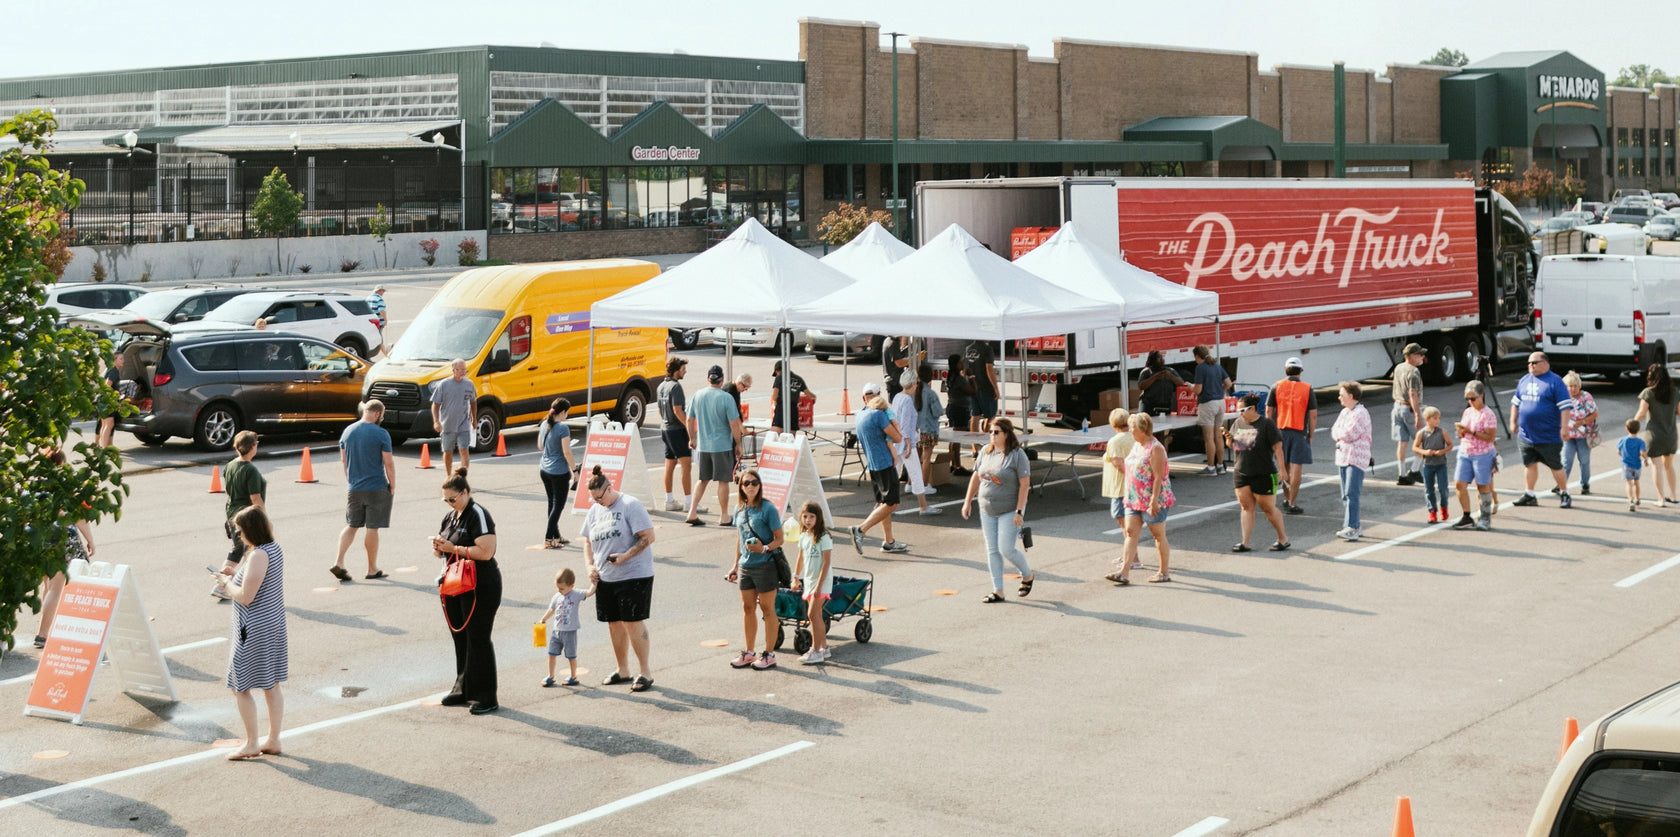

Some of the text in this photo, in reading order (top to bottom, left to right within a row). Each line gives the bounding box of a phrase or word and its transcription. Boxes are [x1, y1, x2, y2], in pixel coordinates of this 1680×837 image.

[1539, 74, 1599, 100] MENARDS
[632, 145, 700, 160] Garden Center
[1158, 206, 1450, 290] THE Peach Truck
[592, 531, 611, 543] UCK
[64, 593, 111, 608] THE PEACH TRUCK
